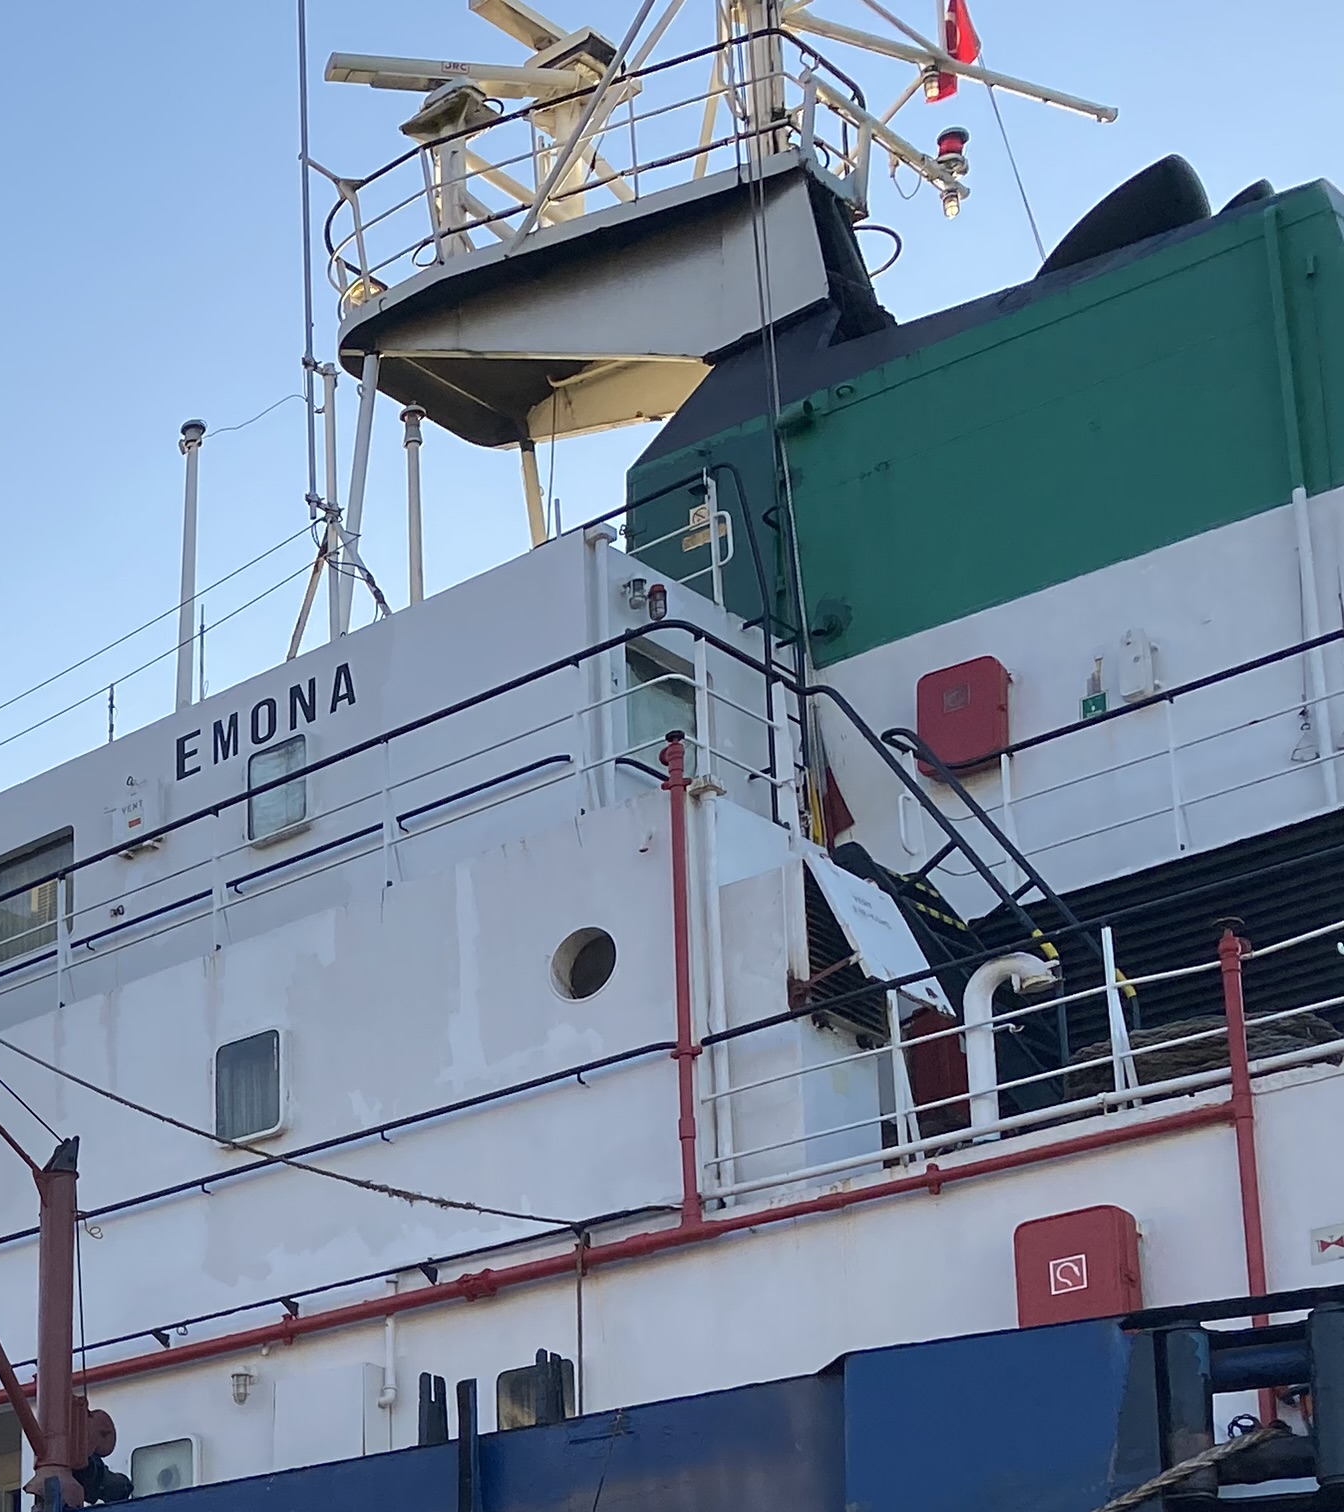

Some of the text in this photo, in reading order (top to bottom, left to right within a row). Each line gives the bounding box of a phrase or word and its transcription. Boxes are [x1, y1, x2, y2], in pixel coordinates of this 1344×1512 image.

[444, 61, 467, 71] JRC
[176, 662, 357, 781] EMONA
[121, 799, 144, 814] VENT
